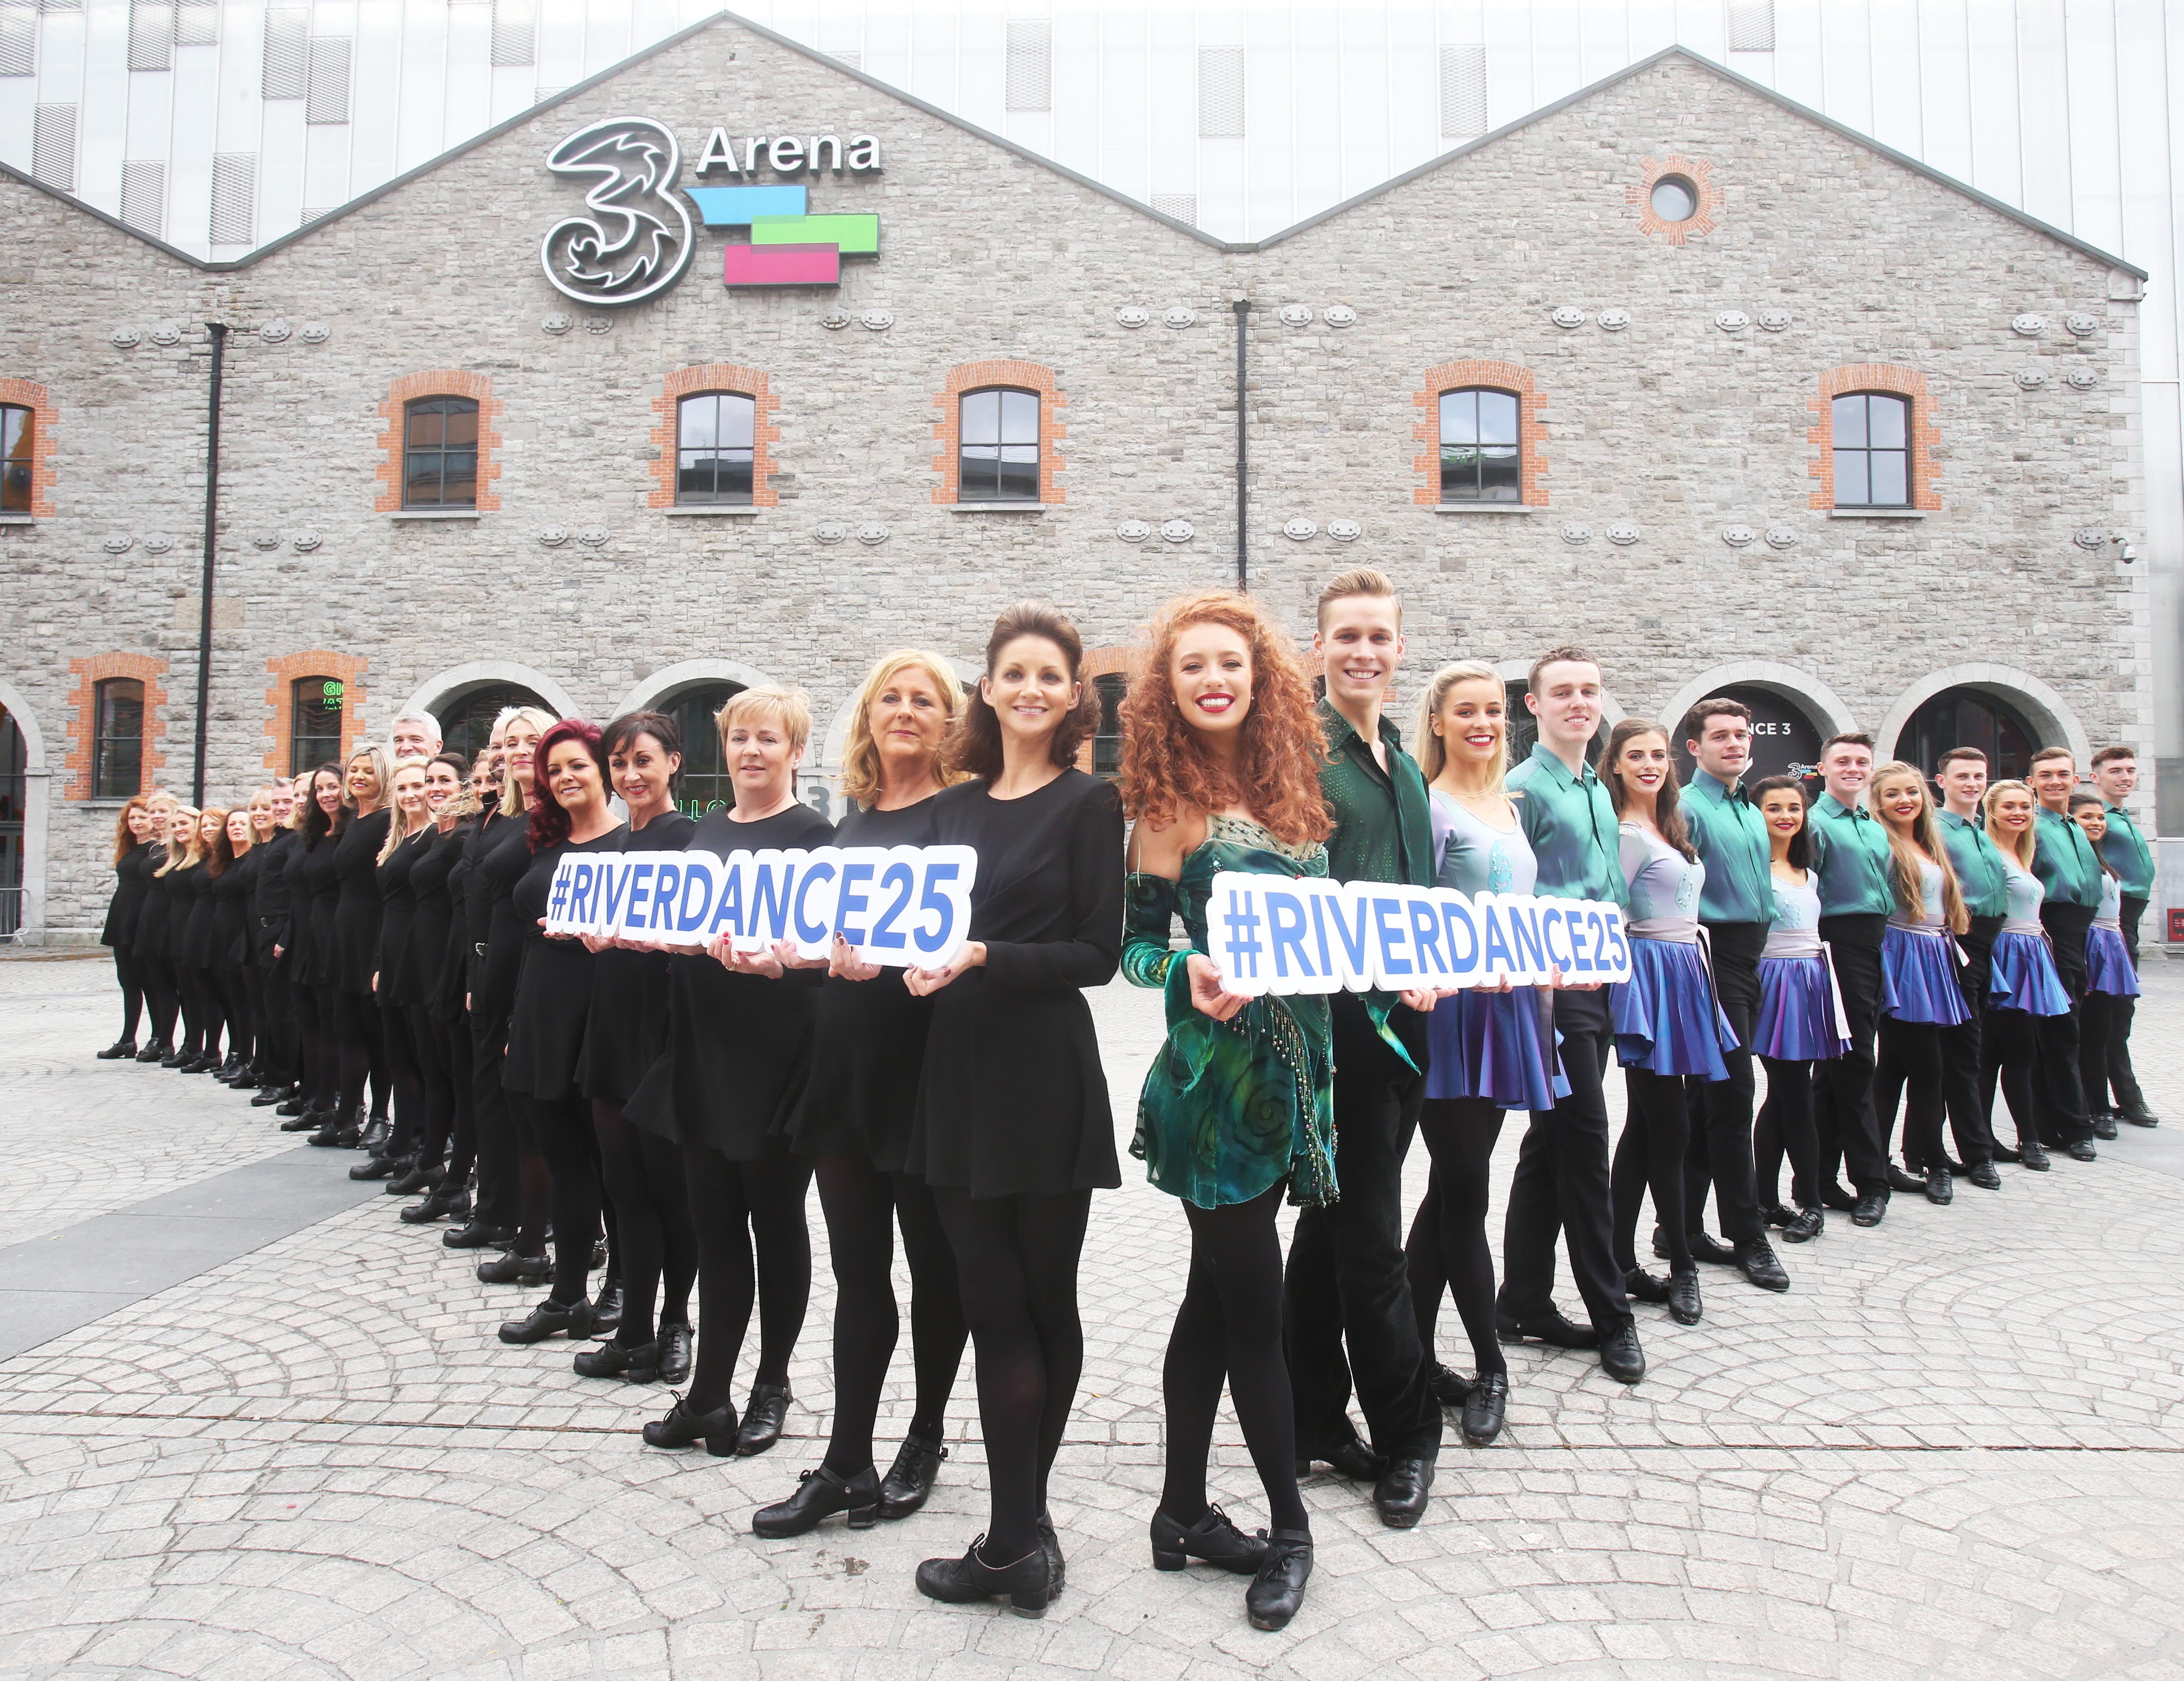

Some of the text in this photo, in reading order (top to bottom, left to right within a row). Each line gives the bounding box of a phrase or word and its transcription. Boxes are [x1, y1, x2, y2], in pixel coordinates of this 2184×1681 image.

[540, 115, 884, 308] 3 Arena
[1782, 723, 1791, 735] 3
[808, 786, 830, 817] 3
[550, 862, 959, 952] #RIVERDANCE25
[1223, 890, 1627, 978] #RIVERDANCE25
